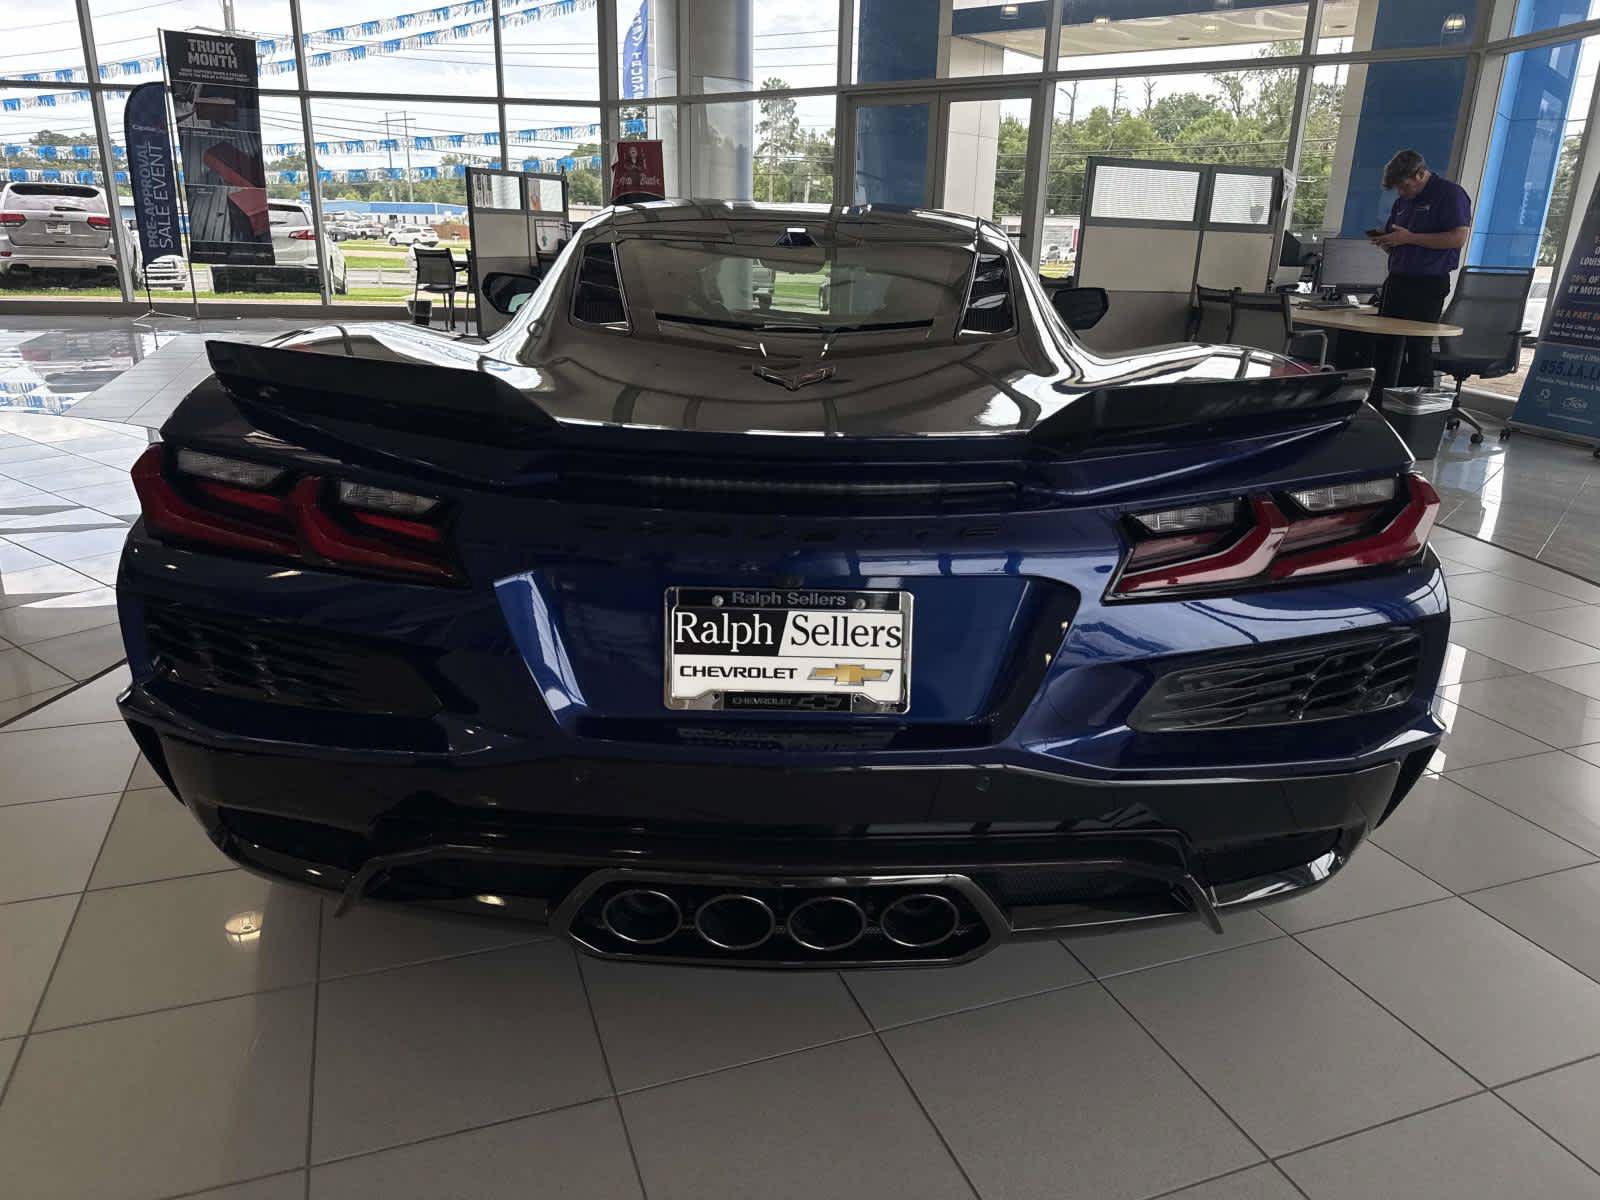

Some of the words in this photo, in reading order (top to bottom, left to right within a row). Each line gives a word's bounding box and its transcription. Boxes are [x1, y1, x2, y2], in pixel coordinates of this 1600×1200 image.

[187, 38, 235, 55] TRUCK
[187, 52, 239, 69] MONTH
[148, 141, 169, 201] EVENT
[136, 140, 160, 249] PRE-APPROVAL
[155, 206, 174, 249] SALE
[732, 591, 782, 606] Ralph
[787, 591, 847, 606] Sellers
[674, 611, 774, 652] Ralph
[790, 614, 902, 649] Sellers
[679, 665, 798, 680] CHEVROLET
[732, 696, 794, 706] CHEVROLET
